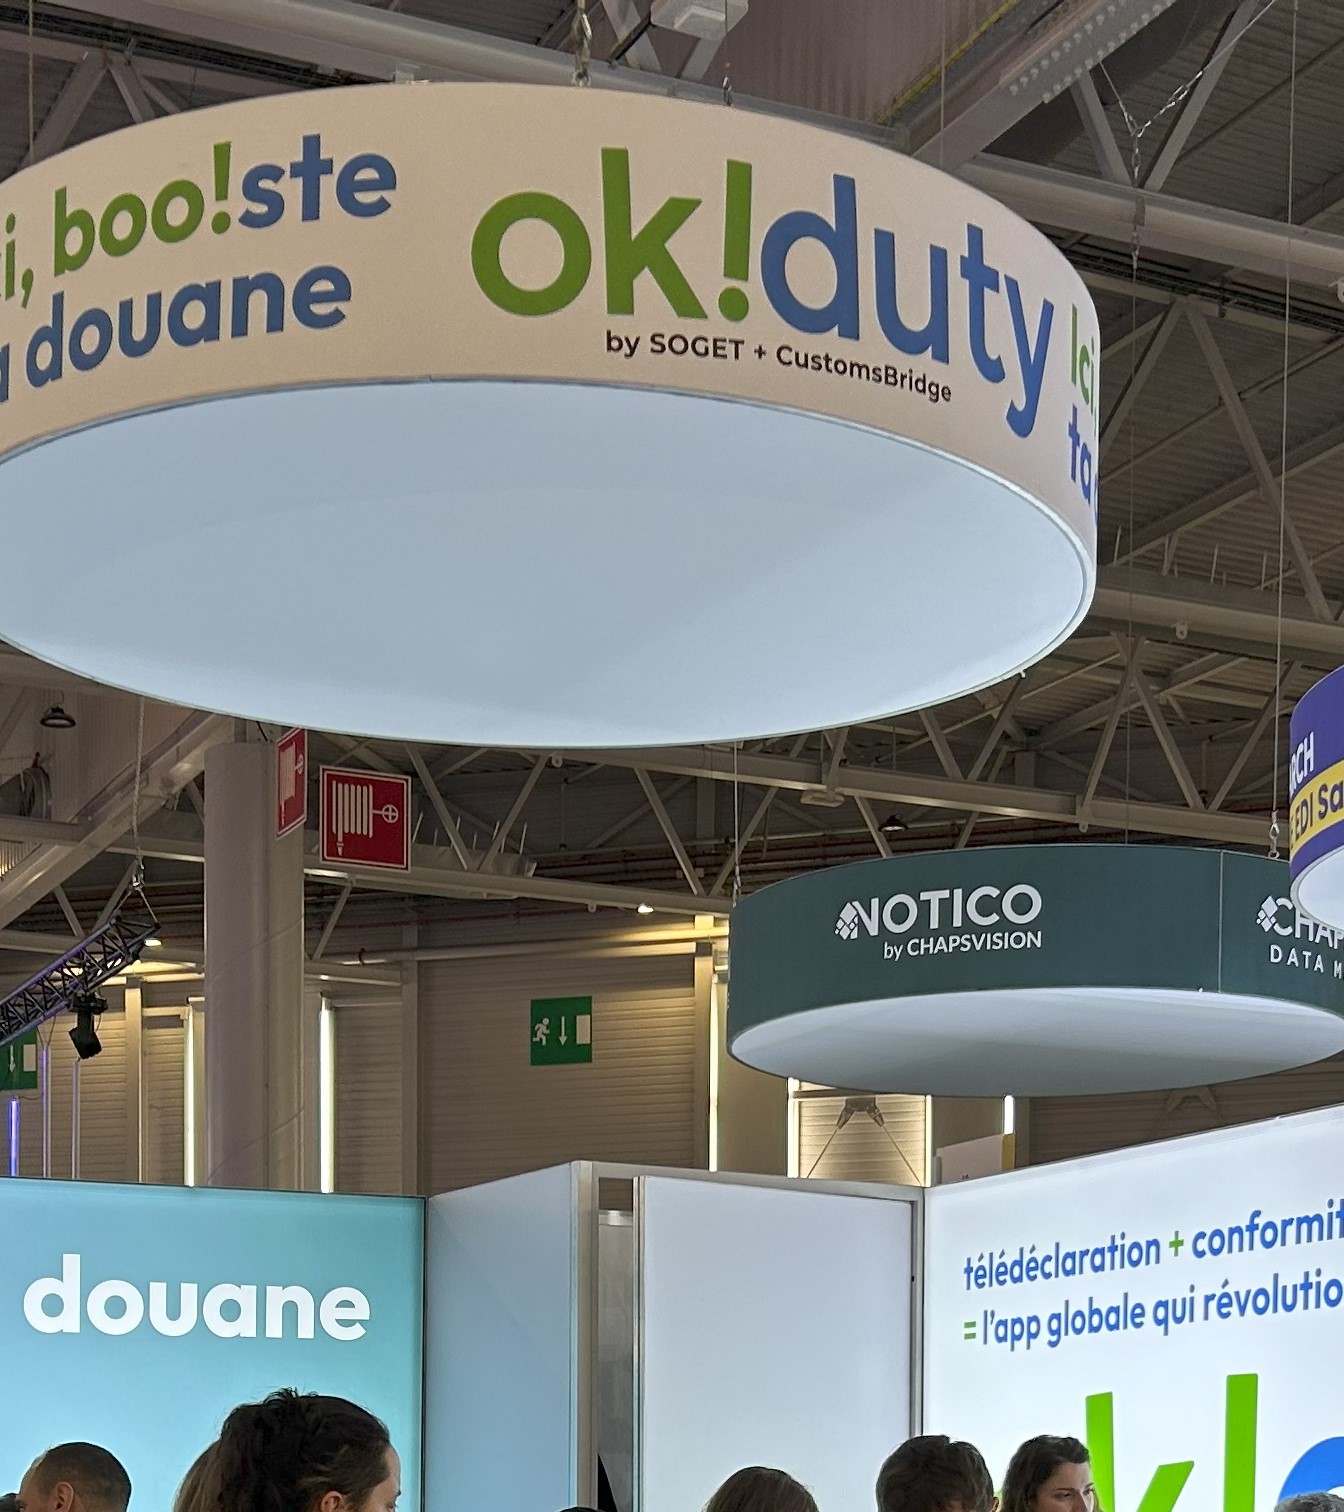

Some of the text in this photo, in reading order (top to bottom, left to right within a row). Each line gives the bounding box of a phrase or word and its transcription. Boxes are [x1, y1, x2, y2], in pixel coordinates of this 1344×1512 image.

[54, 133, 397, 278] boo!ste
[471, 147, 1054, 438] ok!duty
[25, 264, 352, 389] douane
[605, 329, 952, 403] by SOGET + CustomsBridge
[1295, 791, 1314, 842] EDI
[853, 884, 1043, 938] NOTICO
[883, 930, 1043, 961] by CHAPSVISION
[1270, 944, 1325, 974] DATA
[963, 1231, 1161, 1291] télédéclaration
[1168, 1230, 1184, 1257] +
[23, 1253, 371, 1342] douane
[1047, 1291, 1146, 1349] globale
[1153, 1283, 1196, 1337] qui
